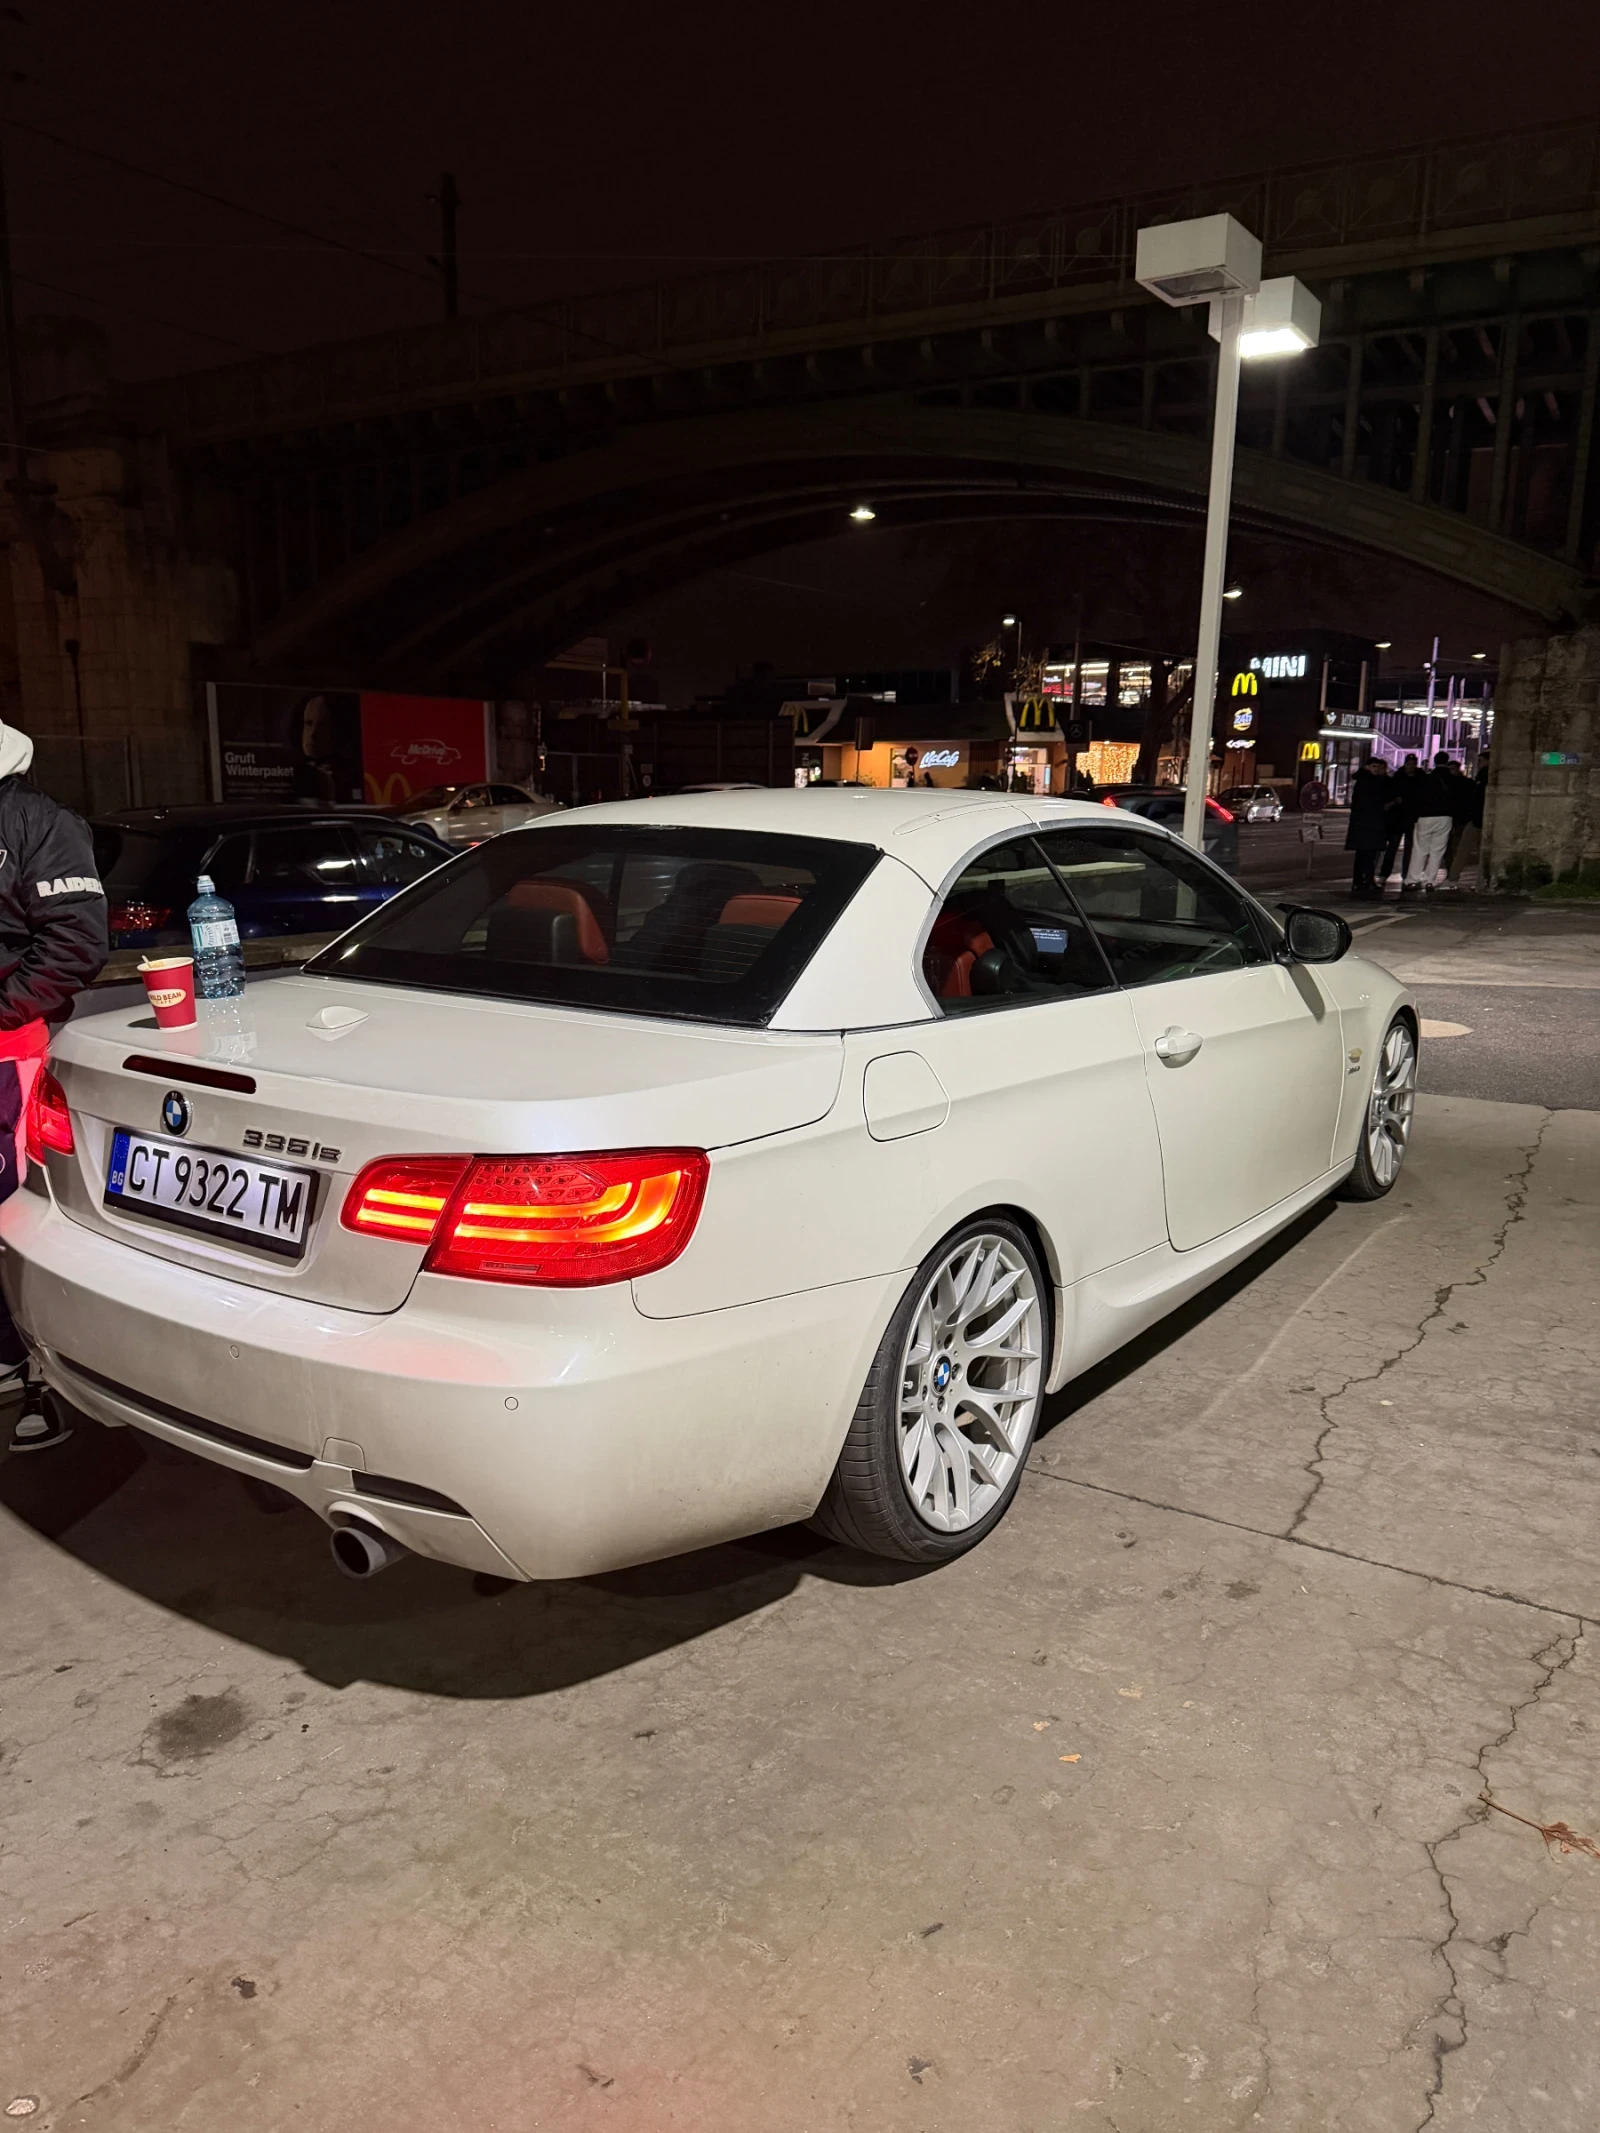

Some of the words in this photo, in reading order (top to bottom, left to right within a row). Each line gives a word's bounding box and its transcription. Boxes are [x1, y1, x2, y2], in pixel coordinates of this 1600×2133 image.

[224, 751, 256, 764] Gruft
[225, 764, 295, 779] Winterpaket
[162, 991, 182, 1001] BEAN
[111, 1170, 124, 1187] BG
[128, 1145, 170, 1197] CT
[174, 1155, 250, 1221] 9322
[258, 1172, 303, 1234] TM
